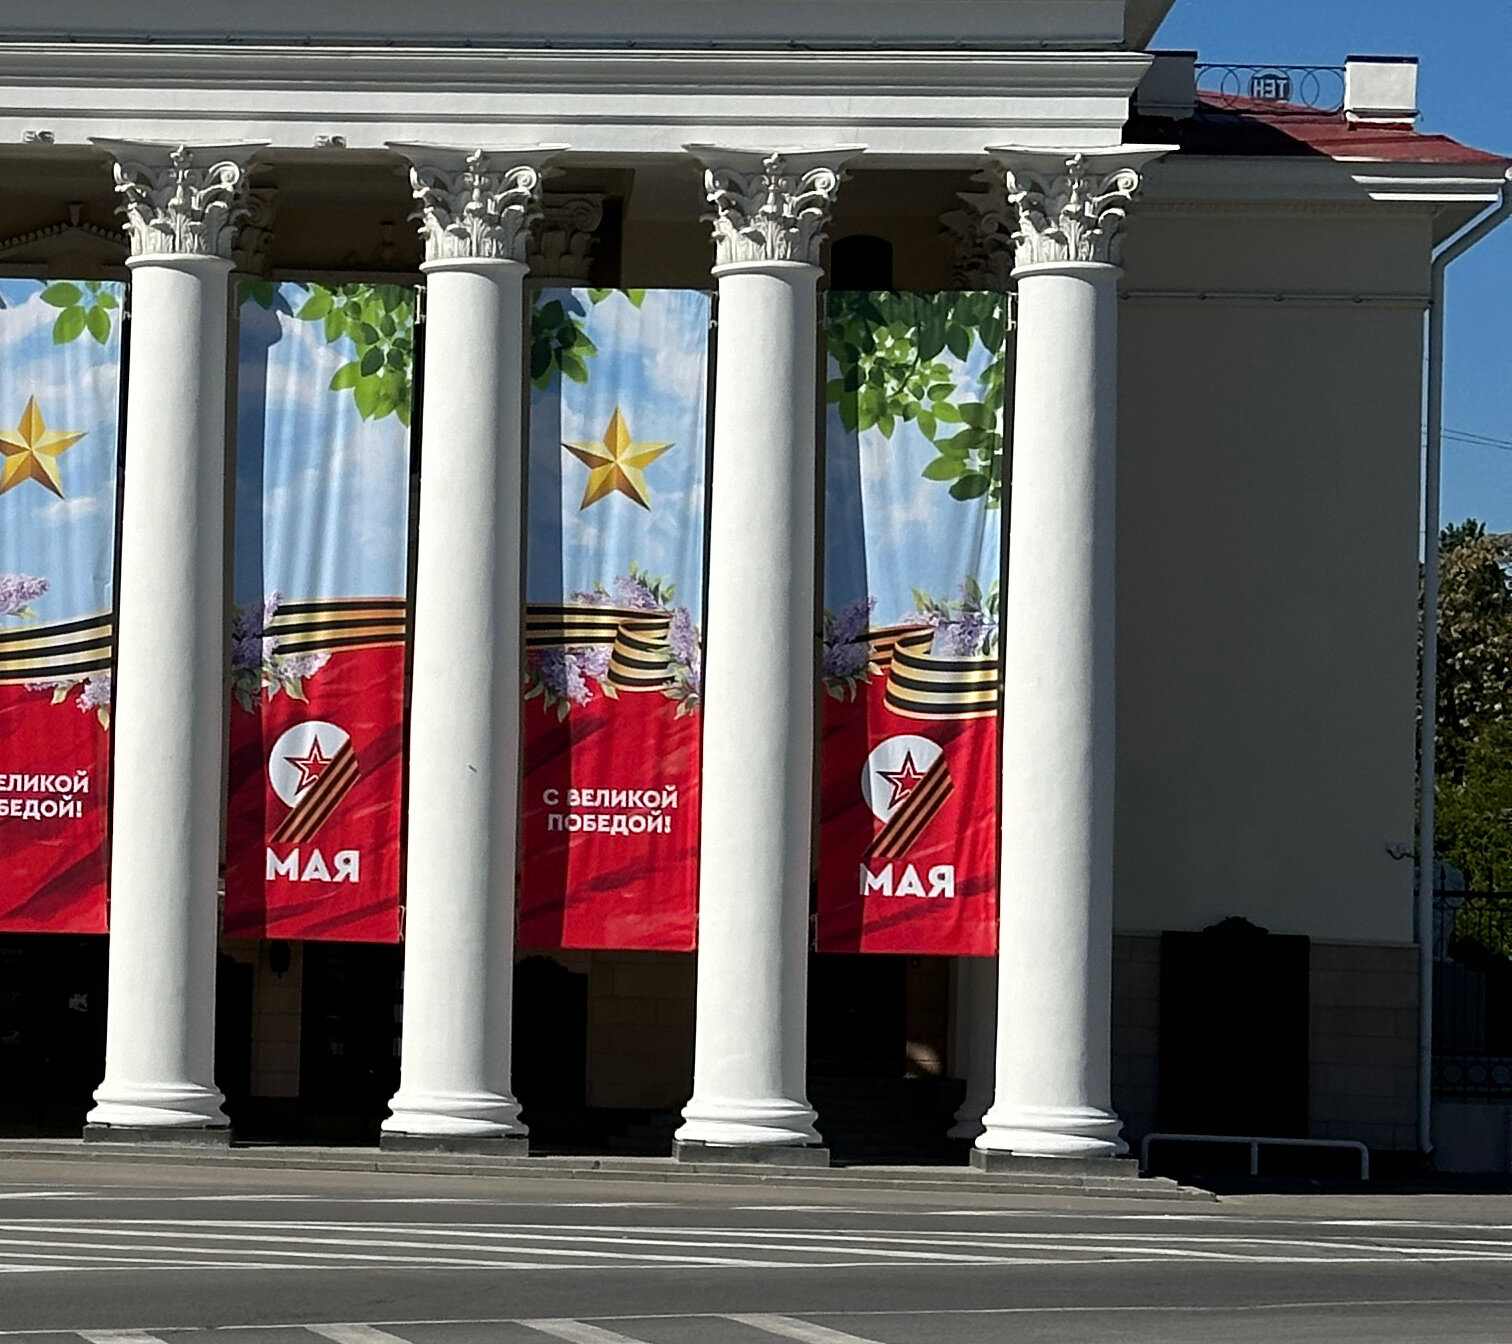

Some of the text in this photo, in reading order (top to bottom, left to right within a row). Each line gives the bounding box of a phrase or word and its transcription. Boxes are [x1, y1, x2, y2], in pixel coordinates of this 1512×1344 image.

[1253, 78, 1288, 99] НЭТ
[543, 785, 678, 809] С ВЕЛИКОЙ
[548, 810, 671, 835] ПОБЕДОЙ!
[266, 847, 360, 882] МАЯ
[859, 862, 955, 898] МАЯ
